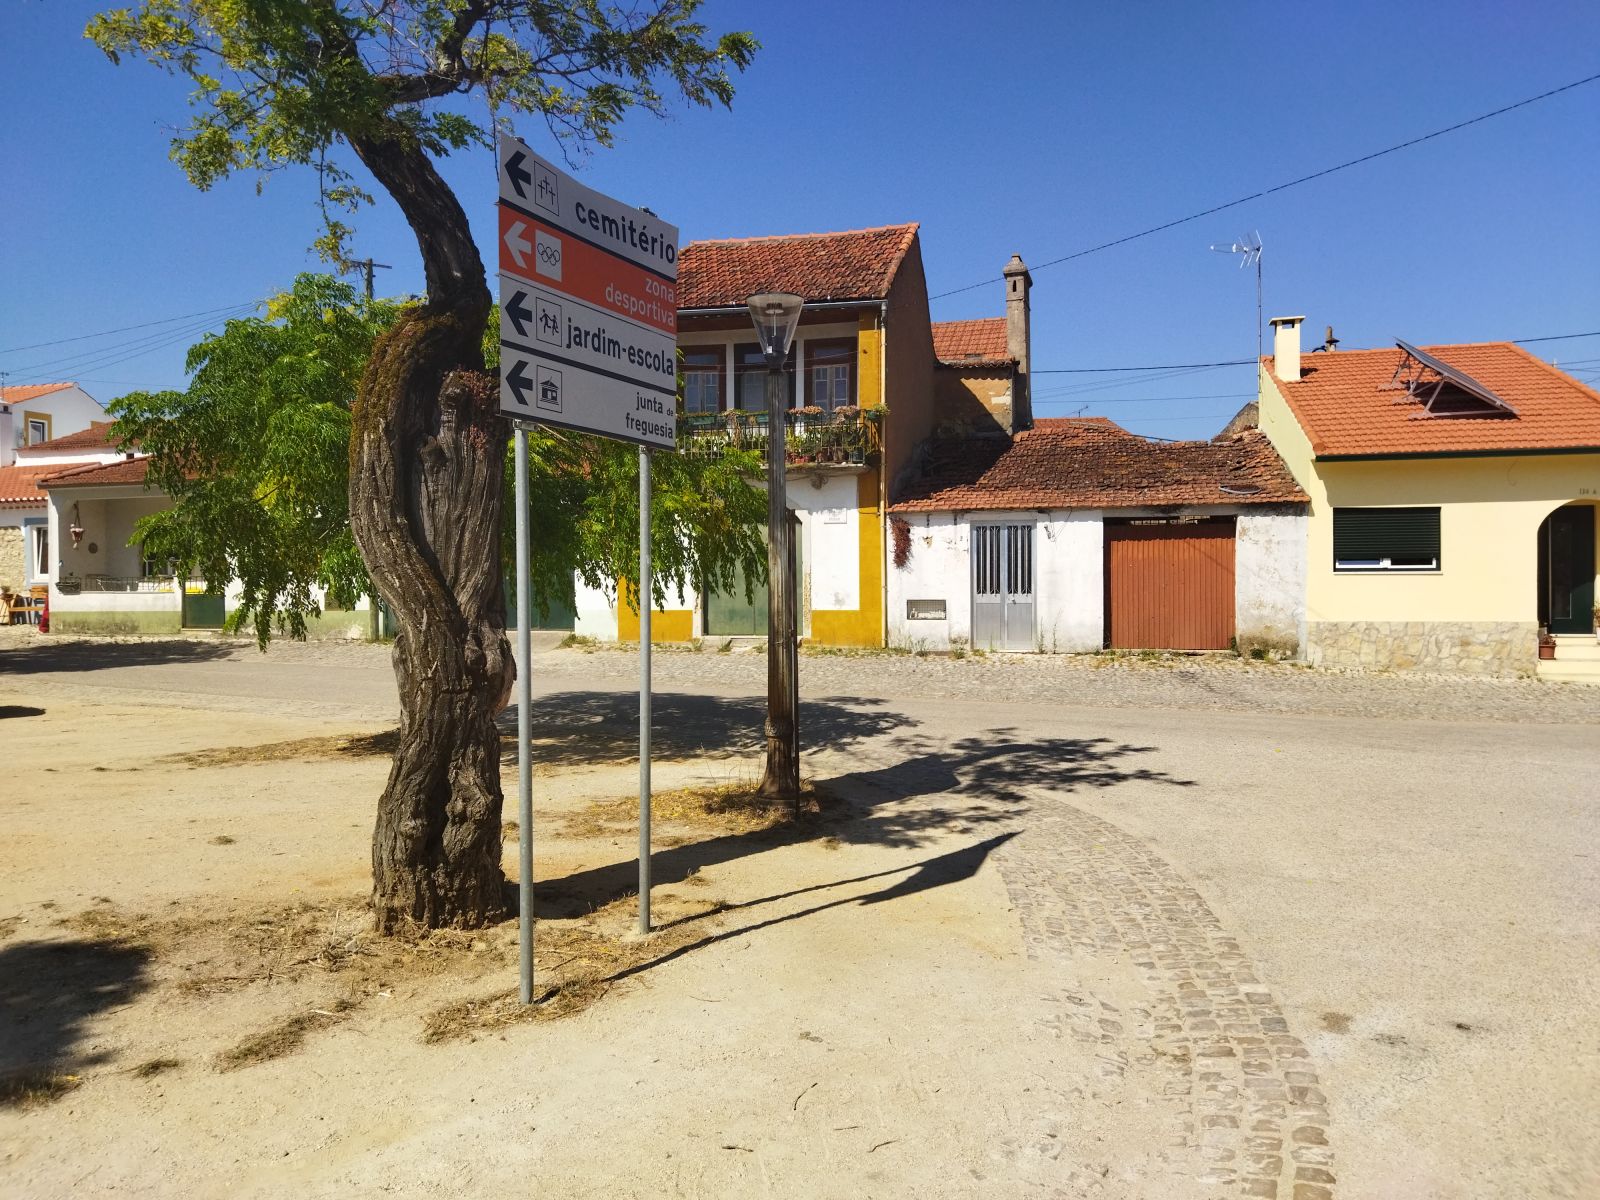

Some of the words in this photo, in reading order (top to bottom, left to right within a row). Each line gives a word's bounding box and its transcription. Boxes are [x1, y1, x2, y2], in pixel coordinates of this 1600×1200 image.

[575, 202, 675, 263] cemitério
[605, 283, 674, 327] desportiva
[645, 278, 674, 303] zona
[566, 317, 674, 376] jardim-escola
[636, 392, 663, 414] junta
[666, 407, 674, 416] de
[625, 412, 673, 439] freguesia
